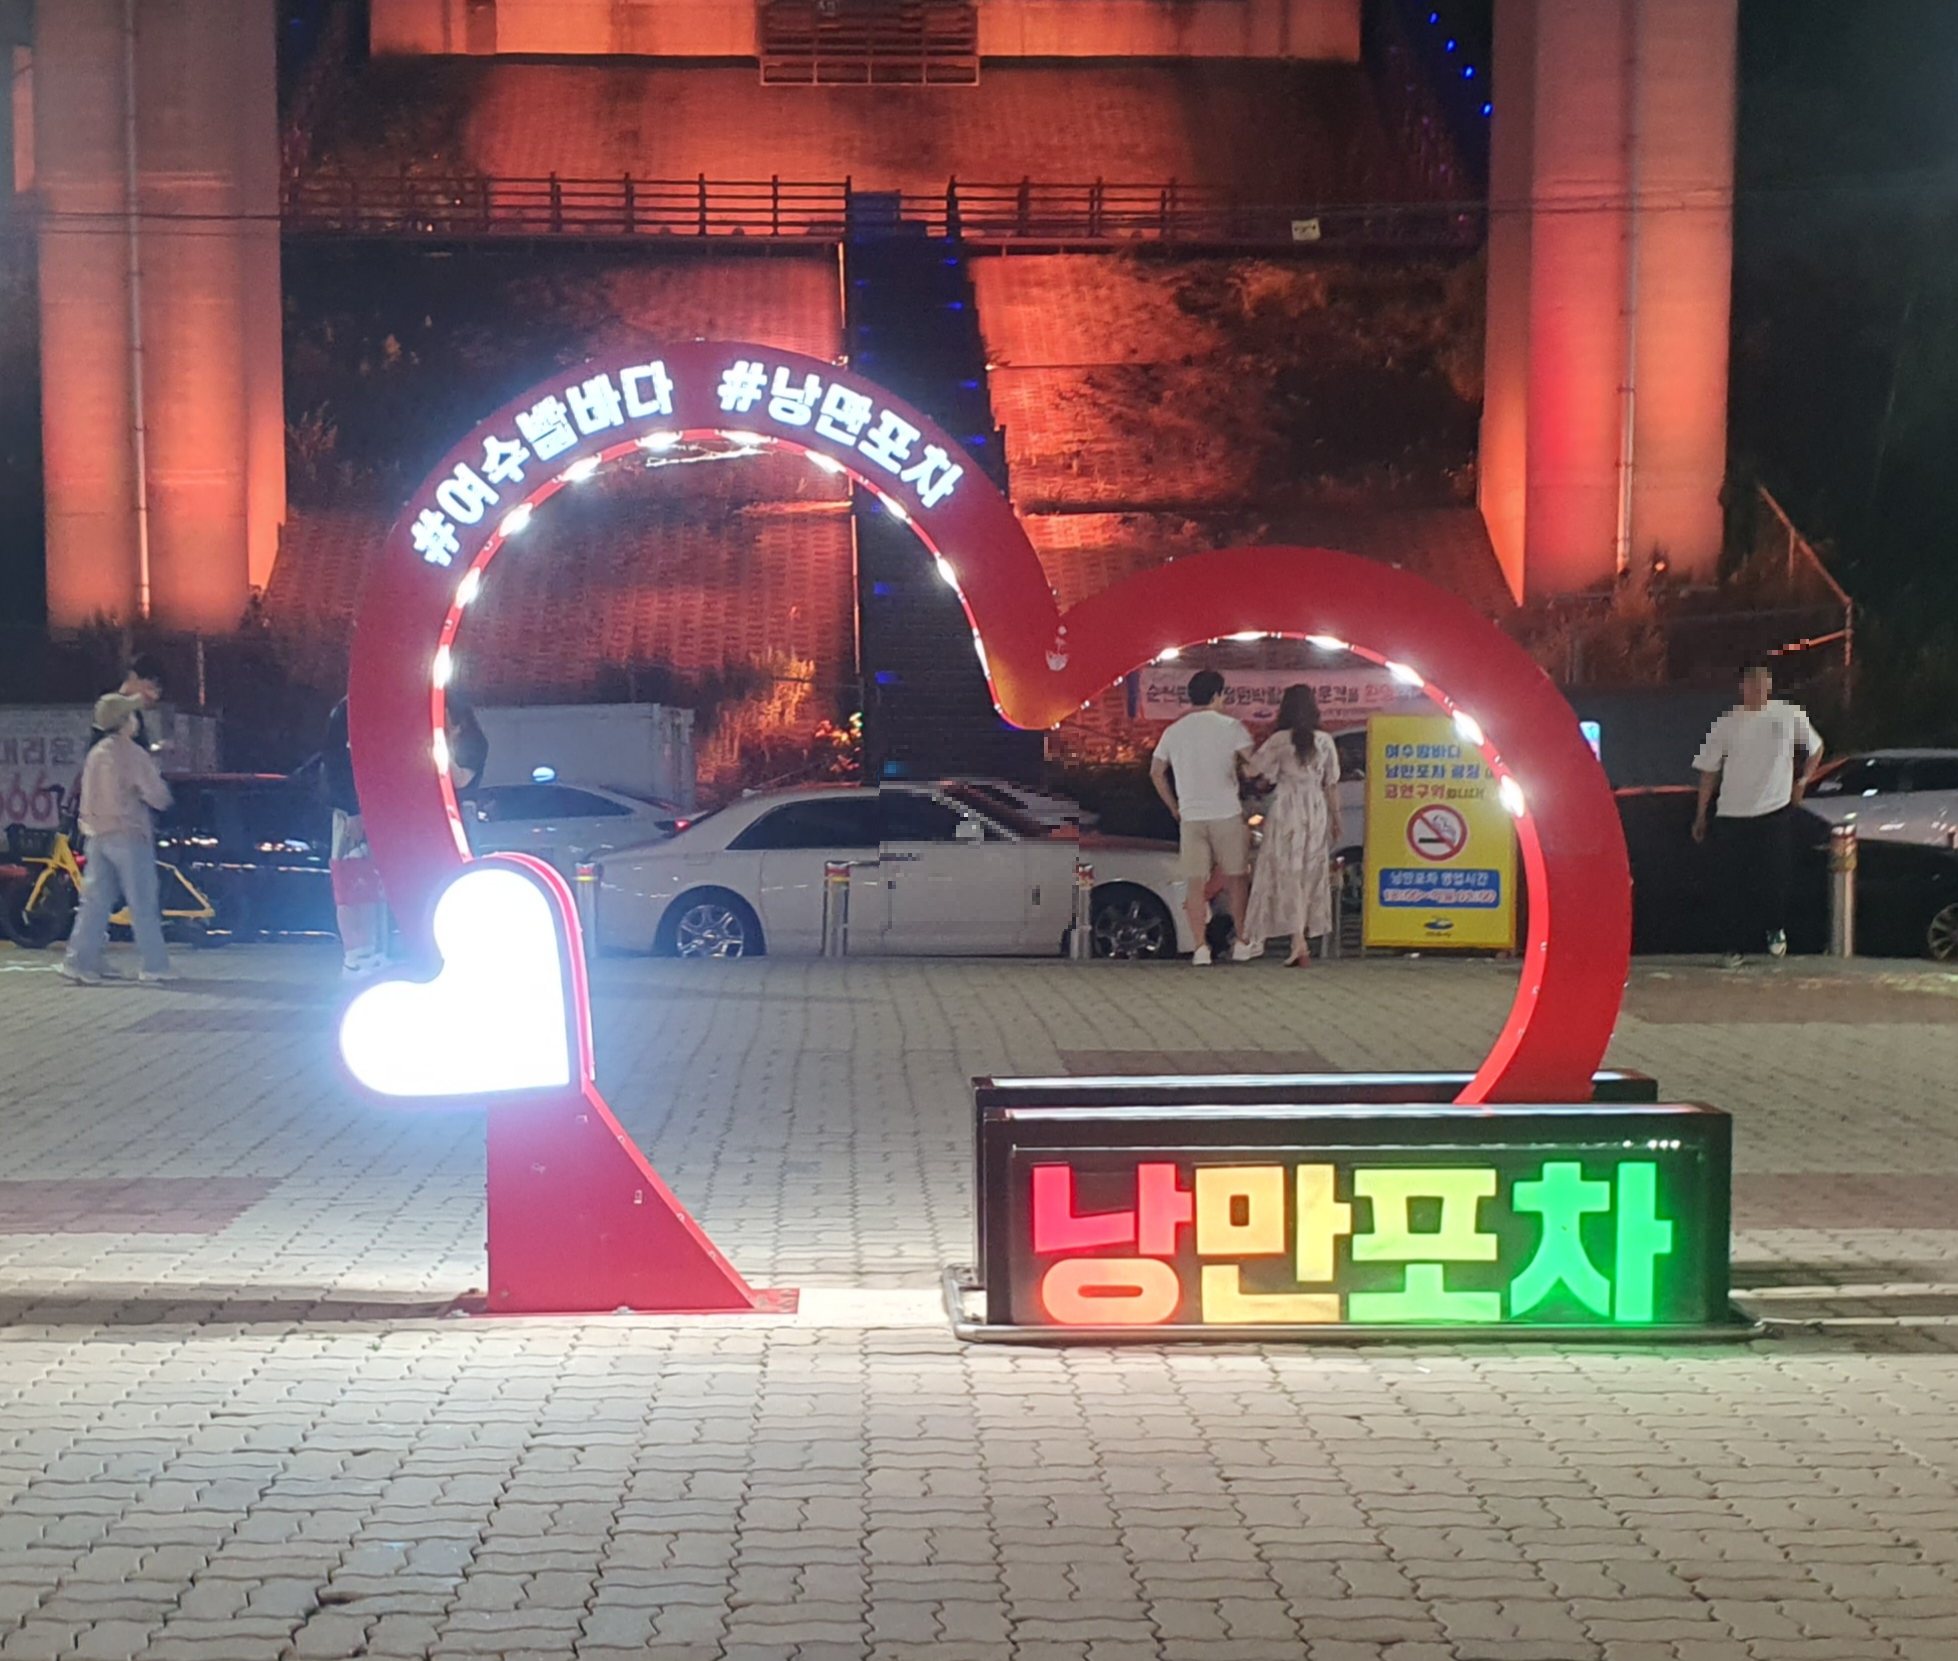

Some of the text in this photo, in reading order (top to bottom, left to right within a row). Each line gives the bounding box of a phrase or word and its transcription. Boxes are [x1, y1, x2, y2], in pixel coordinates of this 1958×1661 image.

[717, 361, 964, 509] #낭만포차
[1385, 764, 1446, 779] 낭만포차
[1032, 1161, 1673, 1324] 낭만포차
